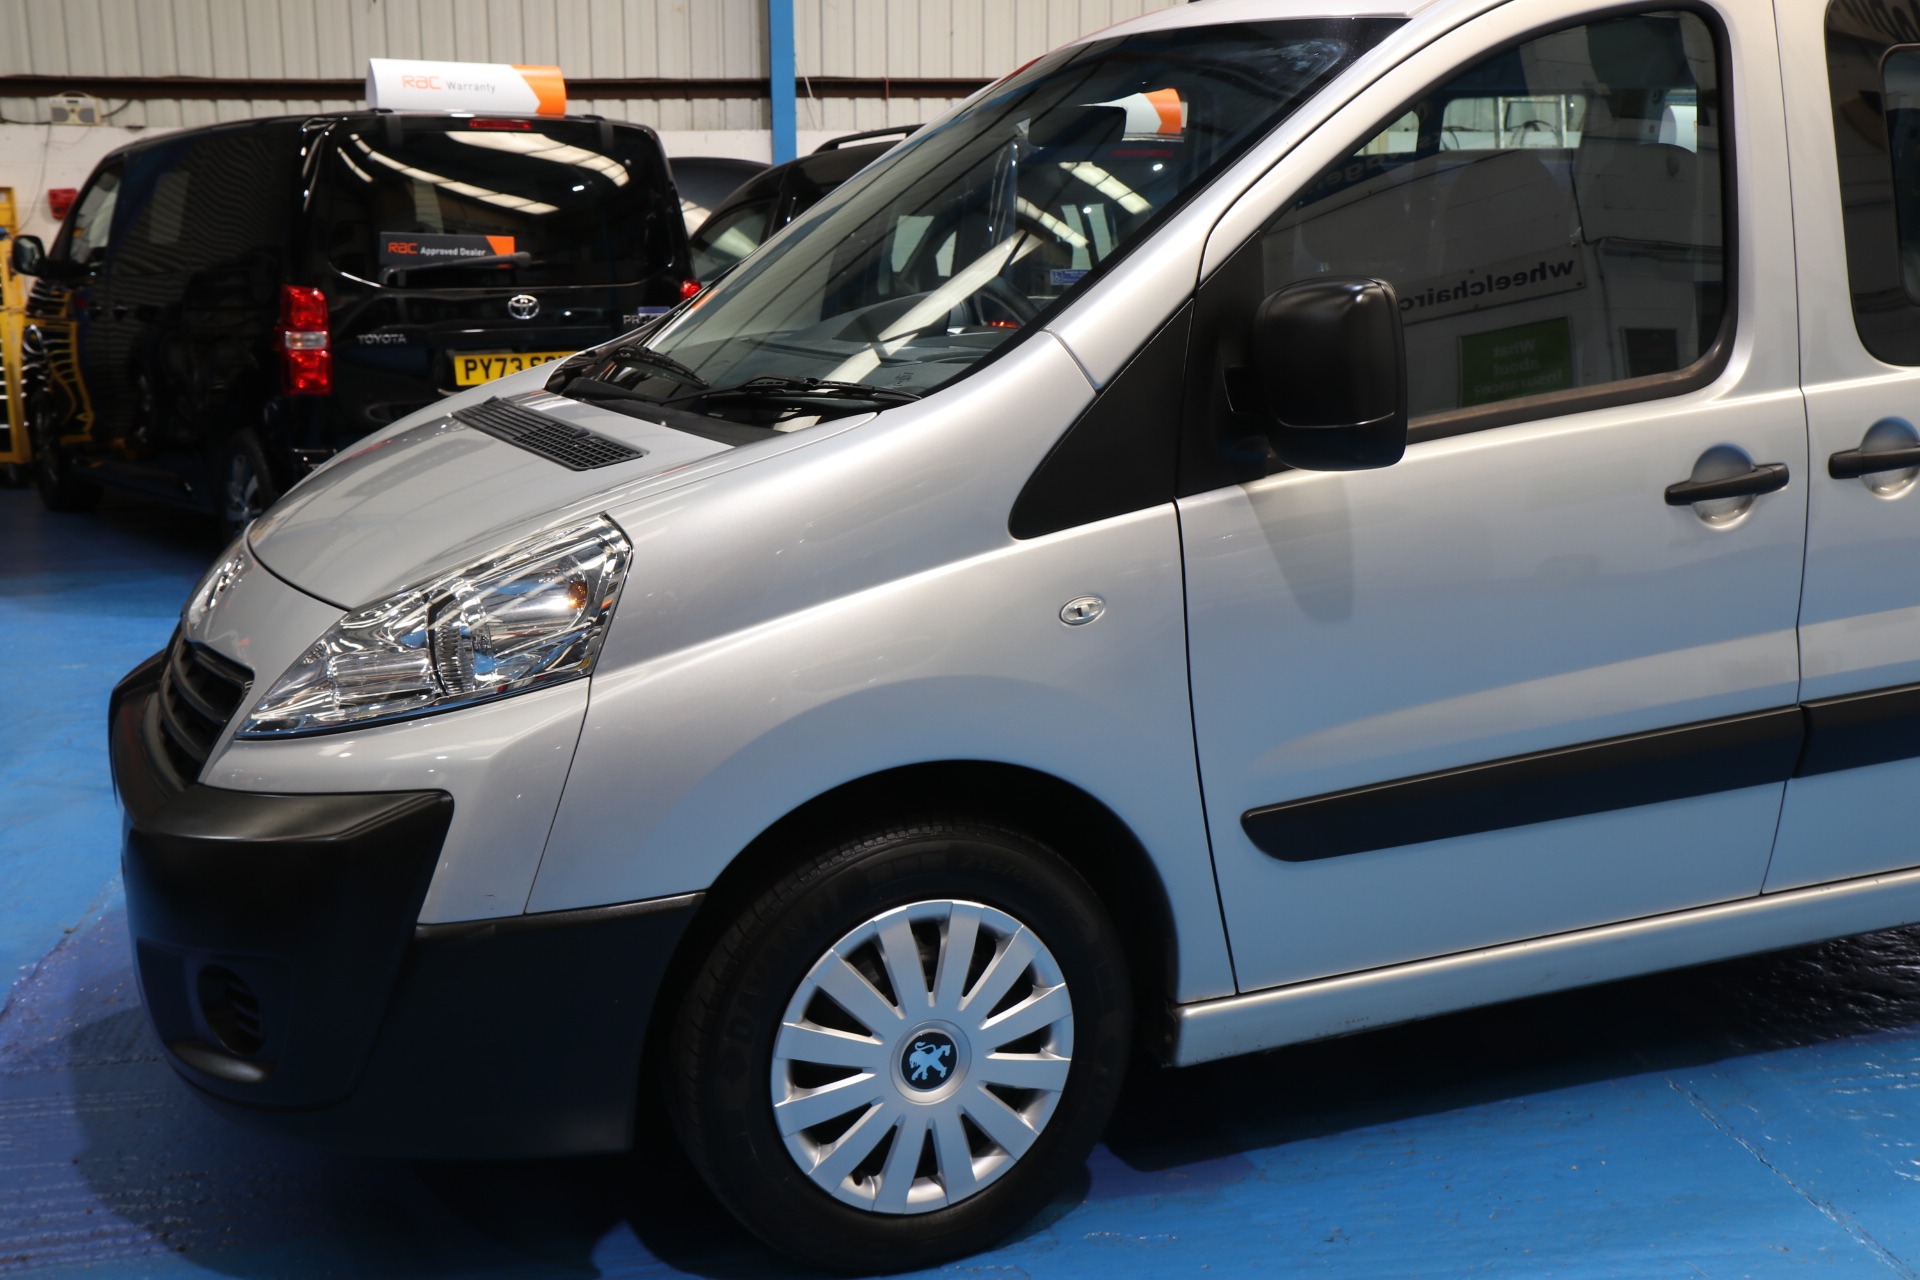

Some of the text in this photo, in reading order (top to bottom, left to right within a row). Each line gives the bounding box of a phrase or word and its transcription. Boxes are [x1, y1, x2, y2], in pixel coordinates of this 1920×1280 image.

[446, 80, 496, 94] Warranty
[420, 246, 458, 257] Approved
[459, 247, 486, 257] Dealer
[357, 333, 407, 345] TOYOTA
